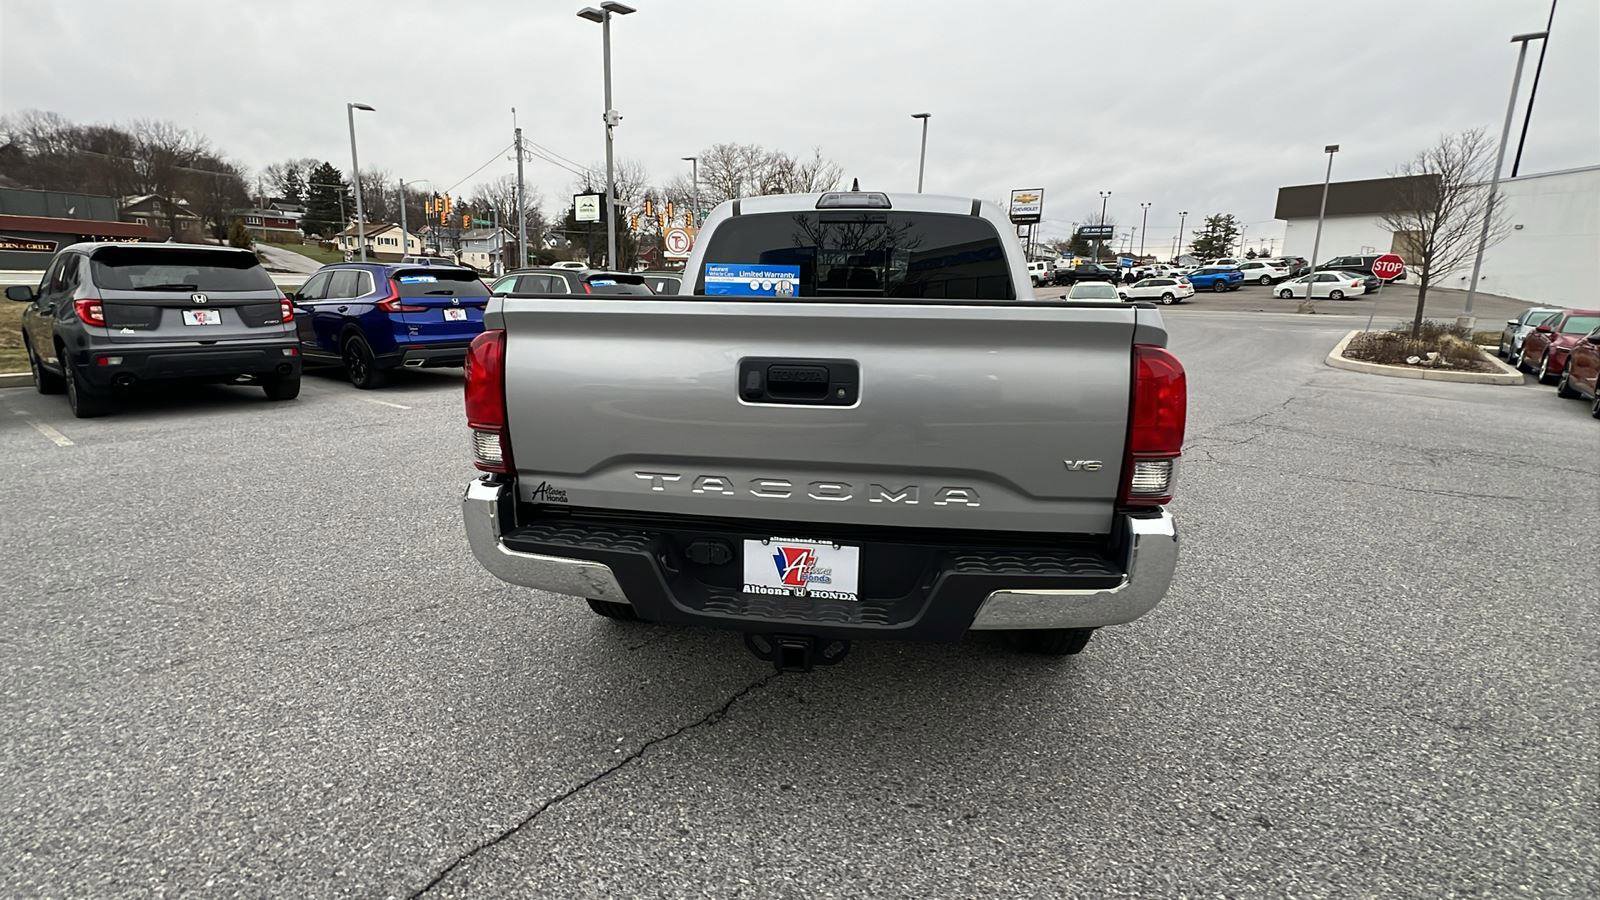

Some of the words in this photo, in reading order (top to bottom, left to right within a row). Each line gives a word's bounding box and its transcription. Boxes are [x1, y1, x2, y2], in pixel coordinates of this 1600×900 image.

[1374, 261, 1402, 272] STOP
[764, 271, 795, 279] Warranty
[1064, 460, 1103, 471] V6
[634, 471, 982, 507] TACOMA
[546, 495, 568, 503] Honda
[801, 573, 831, 584] Honda
[742, 584, 790, 596] Altoona
[810, 589, 859, 601] HONDA
